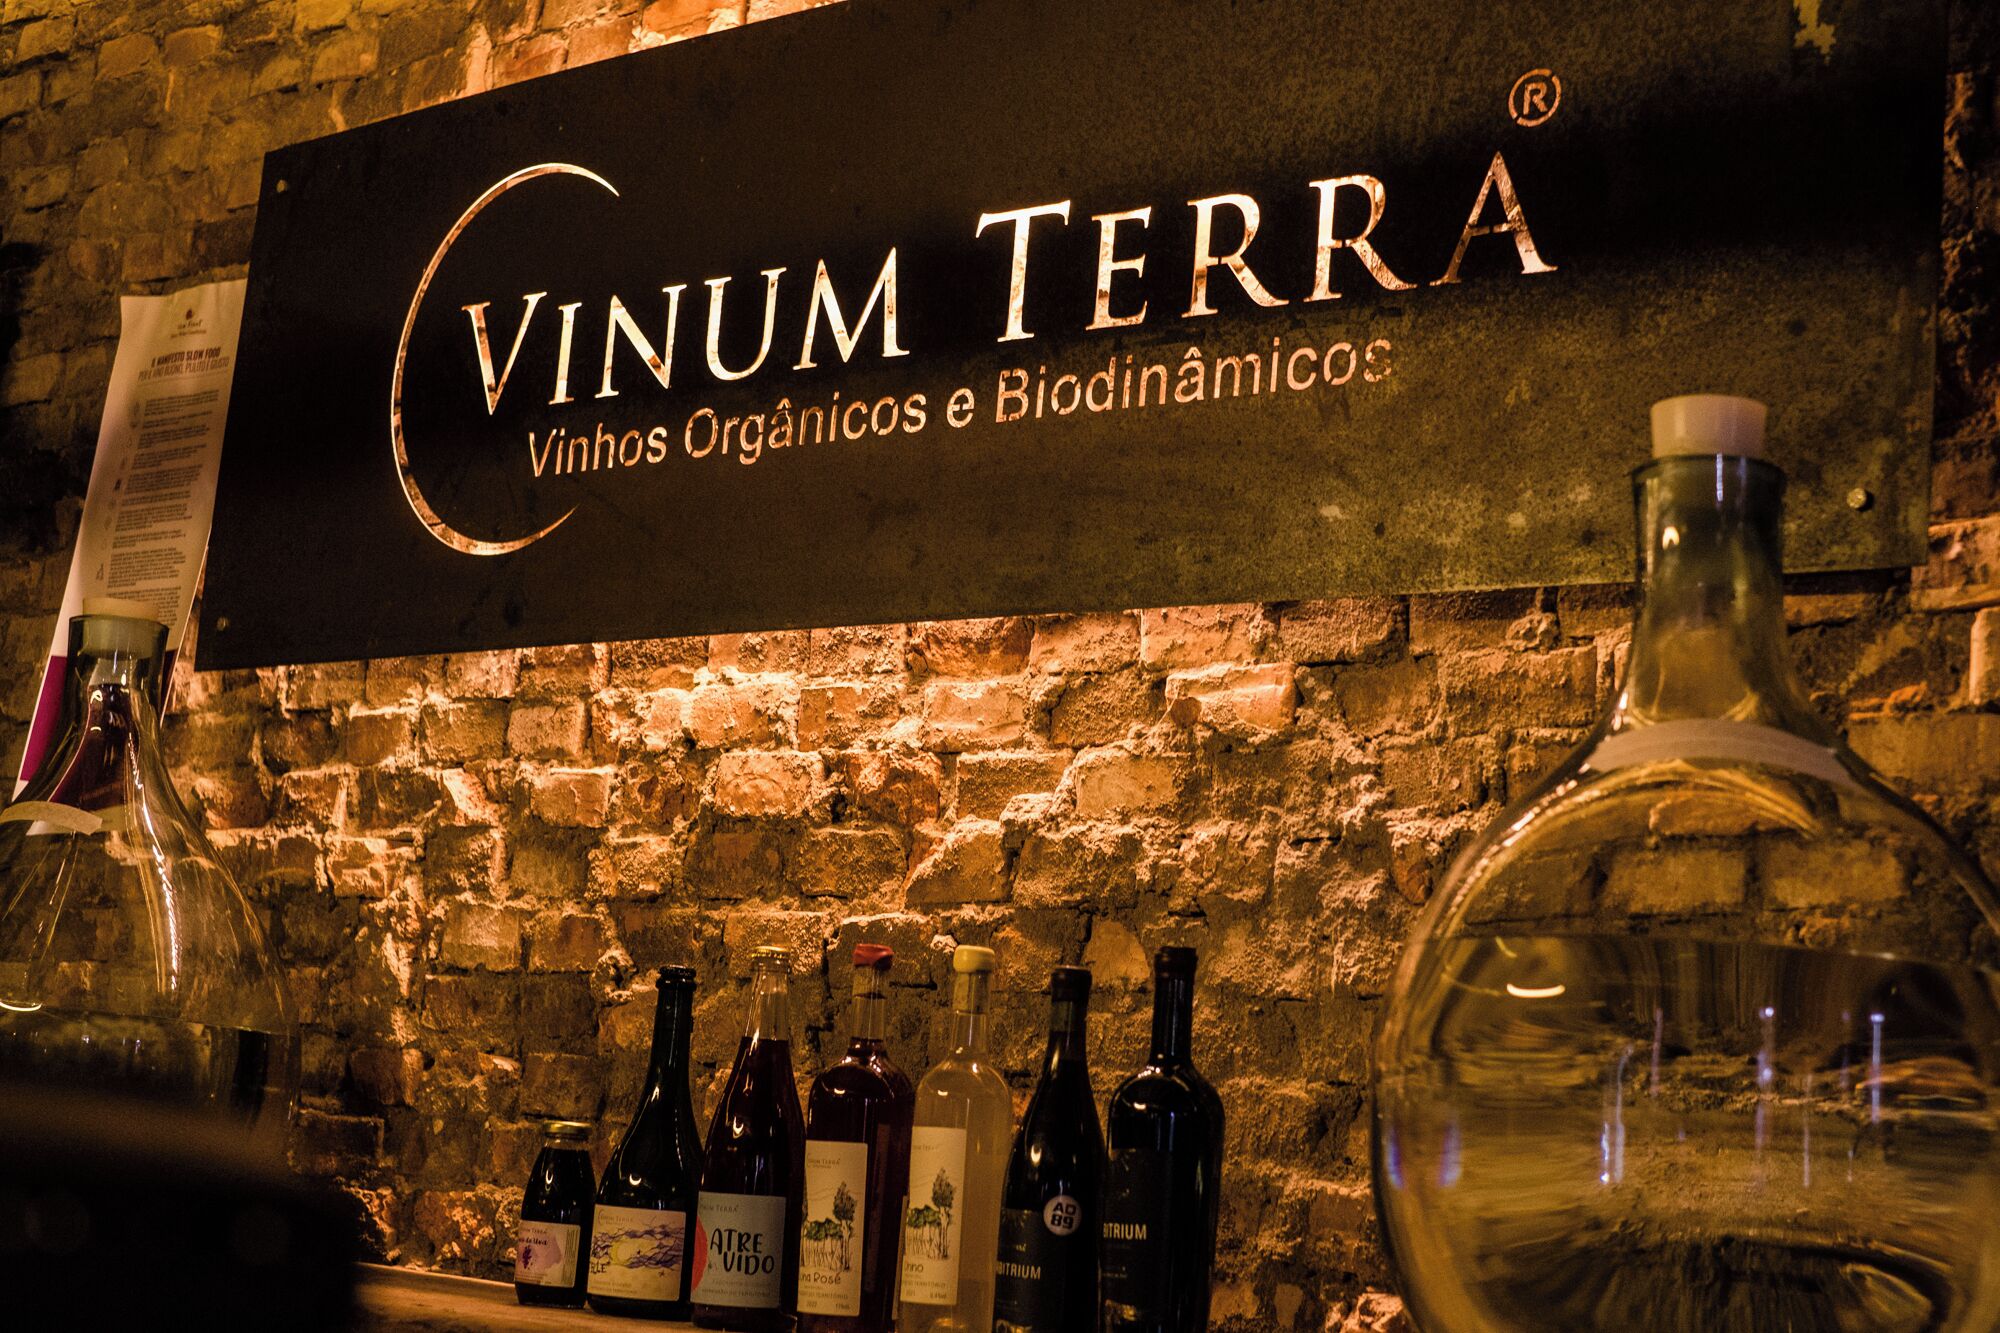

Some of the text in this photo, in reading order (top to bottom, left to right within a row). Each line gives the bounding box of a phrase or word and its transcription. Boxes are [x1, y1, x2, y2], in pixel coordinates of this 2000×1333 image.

[461, 150, 1558, 416] VINUM TERRA
[186, 350, 204, 361] SLOW
[205, 346, 221, 360] FOOD
[527, 336, 1394, 478] Vinhos Orgânicos e Biodinâmicos
[1053, 1202, 1077, 1216] AD
[1051, 1213, 1074, 1230] 89
[710, 1228, 763, 1255] ATRE
[723, 1251, 775, 1276] VIDO
[813, 1270, 841, 1285] Rosé
